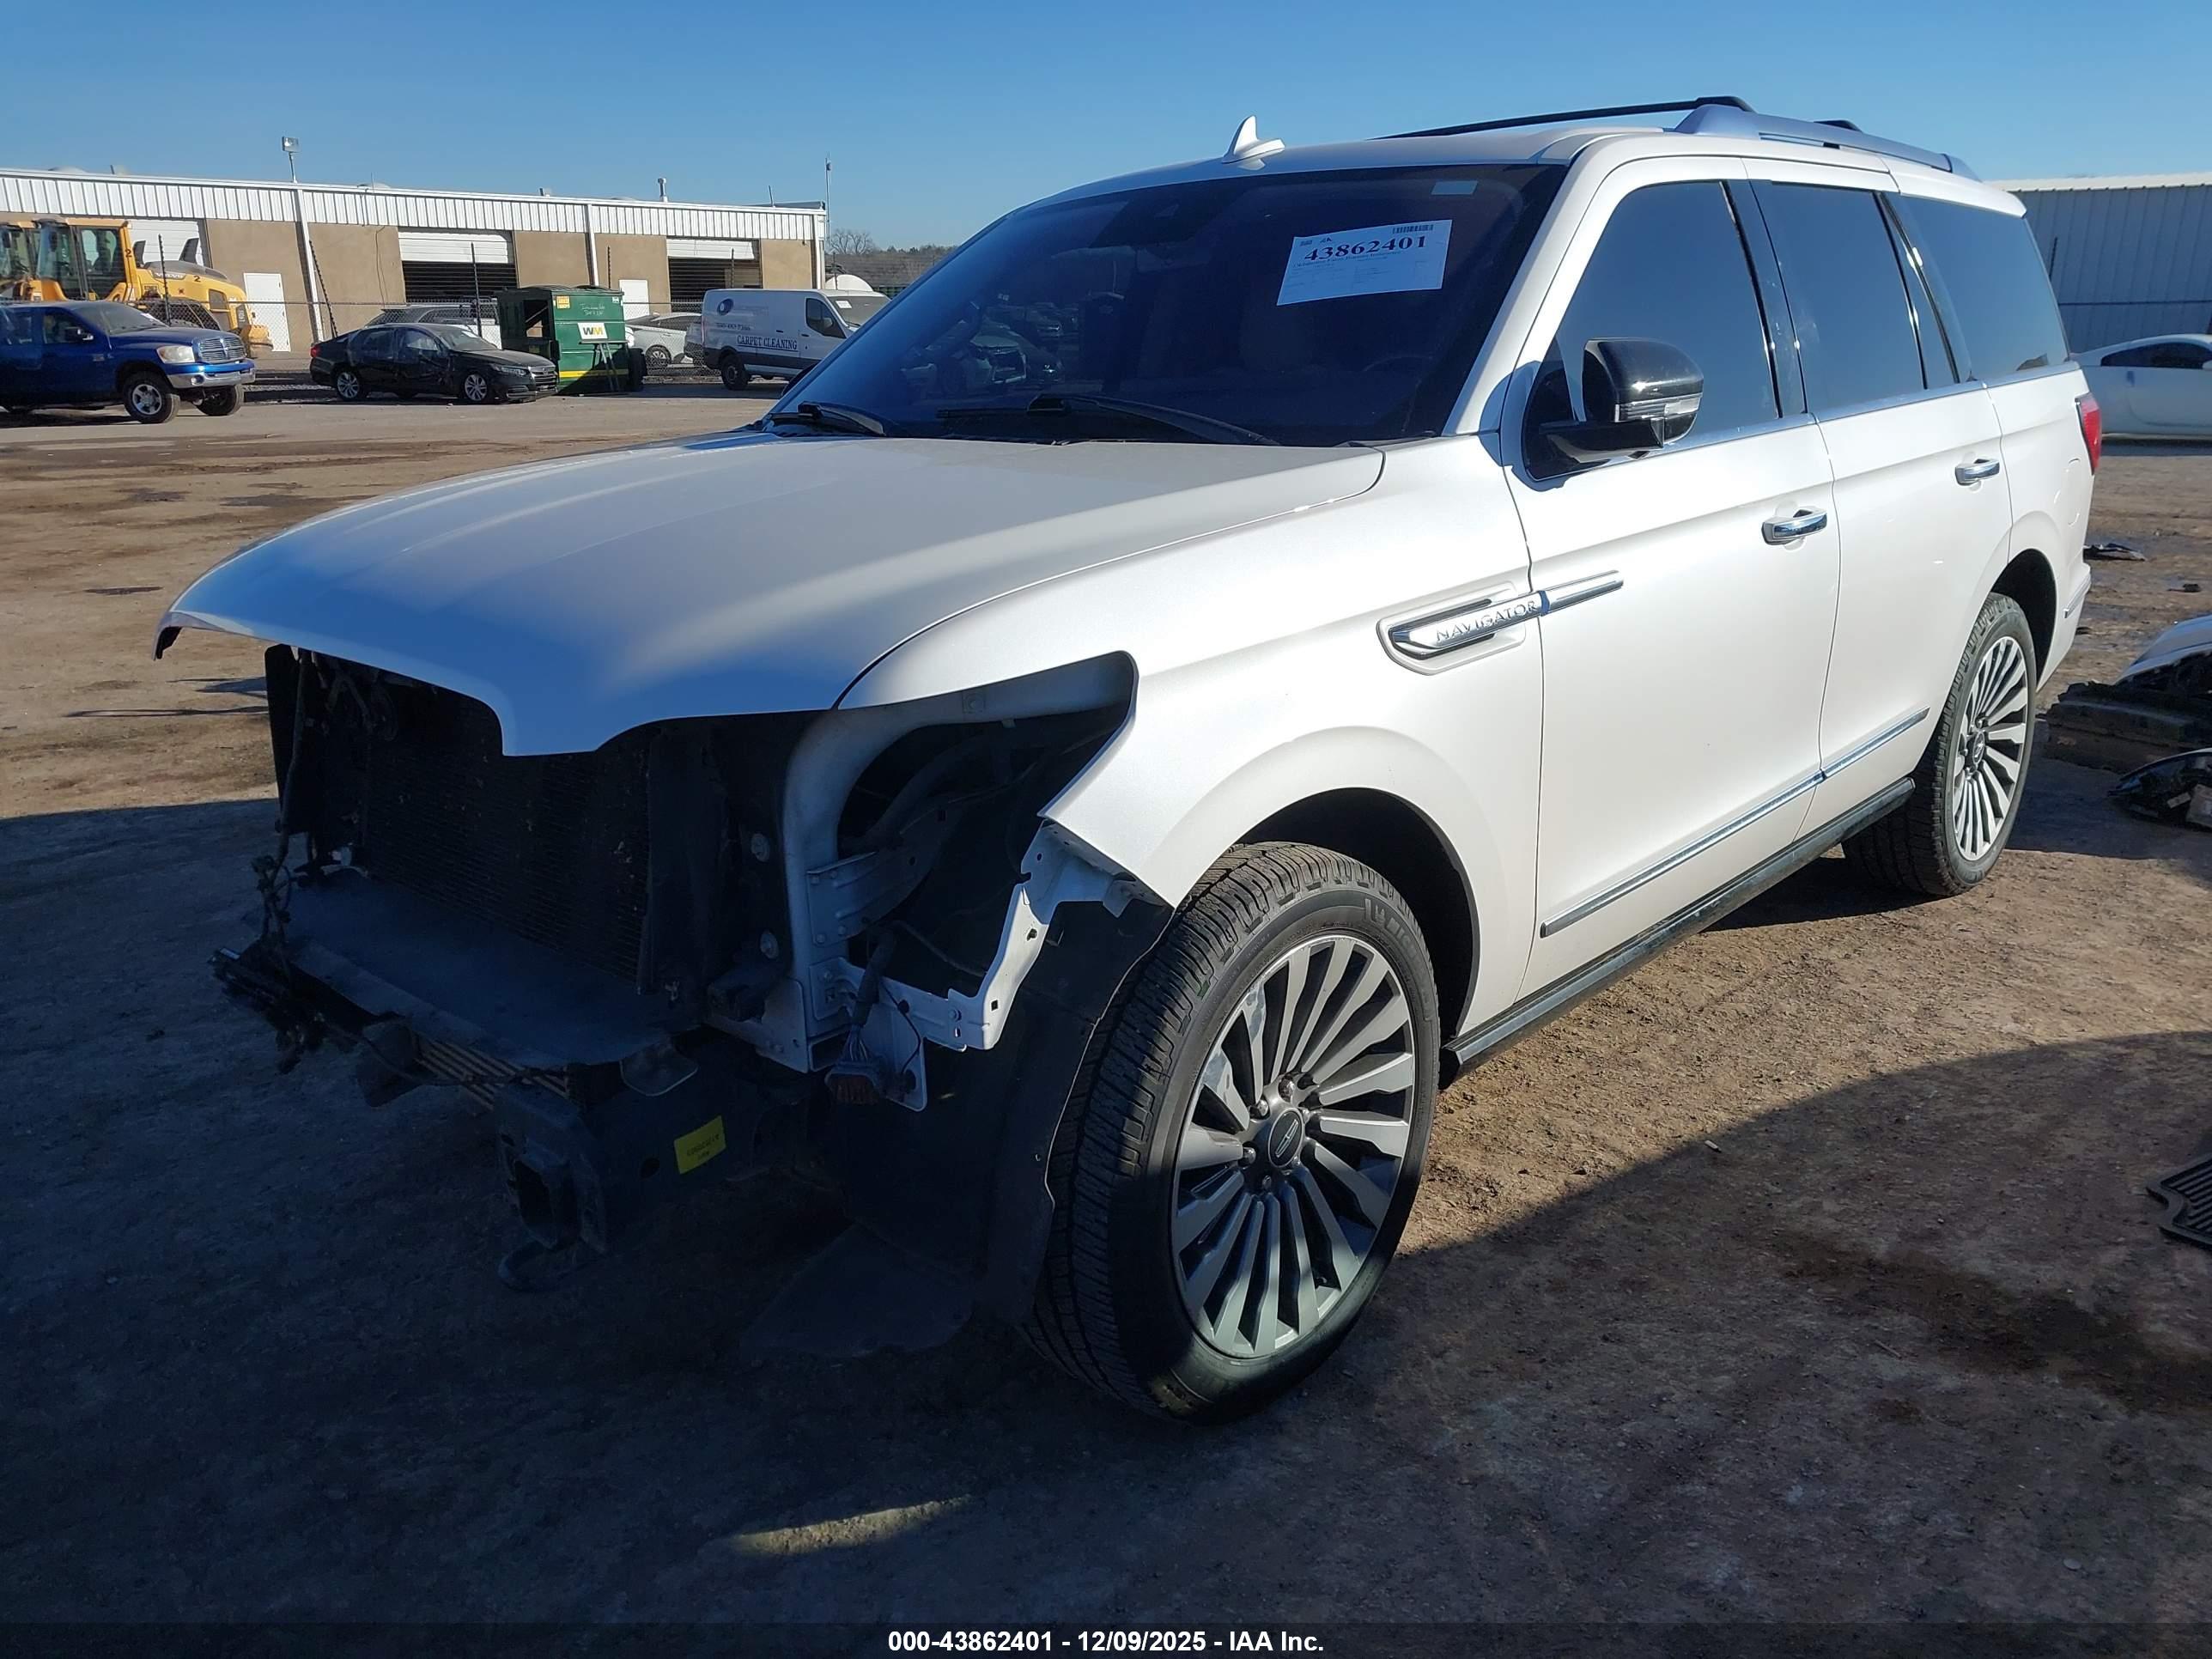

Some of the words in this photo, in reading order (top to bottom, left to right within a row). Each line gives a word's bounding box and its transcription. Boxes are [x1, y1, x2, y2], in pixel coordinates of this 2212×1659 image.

[1304, 235, 1427, 261] 43862401
[582, 326, 604, 336] WM
[737, 335, 763, 346] CARPET
[763, 337, 798, 349] CLEANING
[1436, 600, 1538, 641] NAVIGATOR
